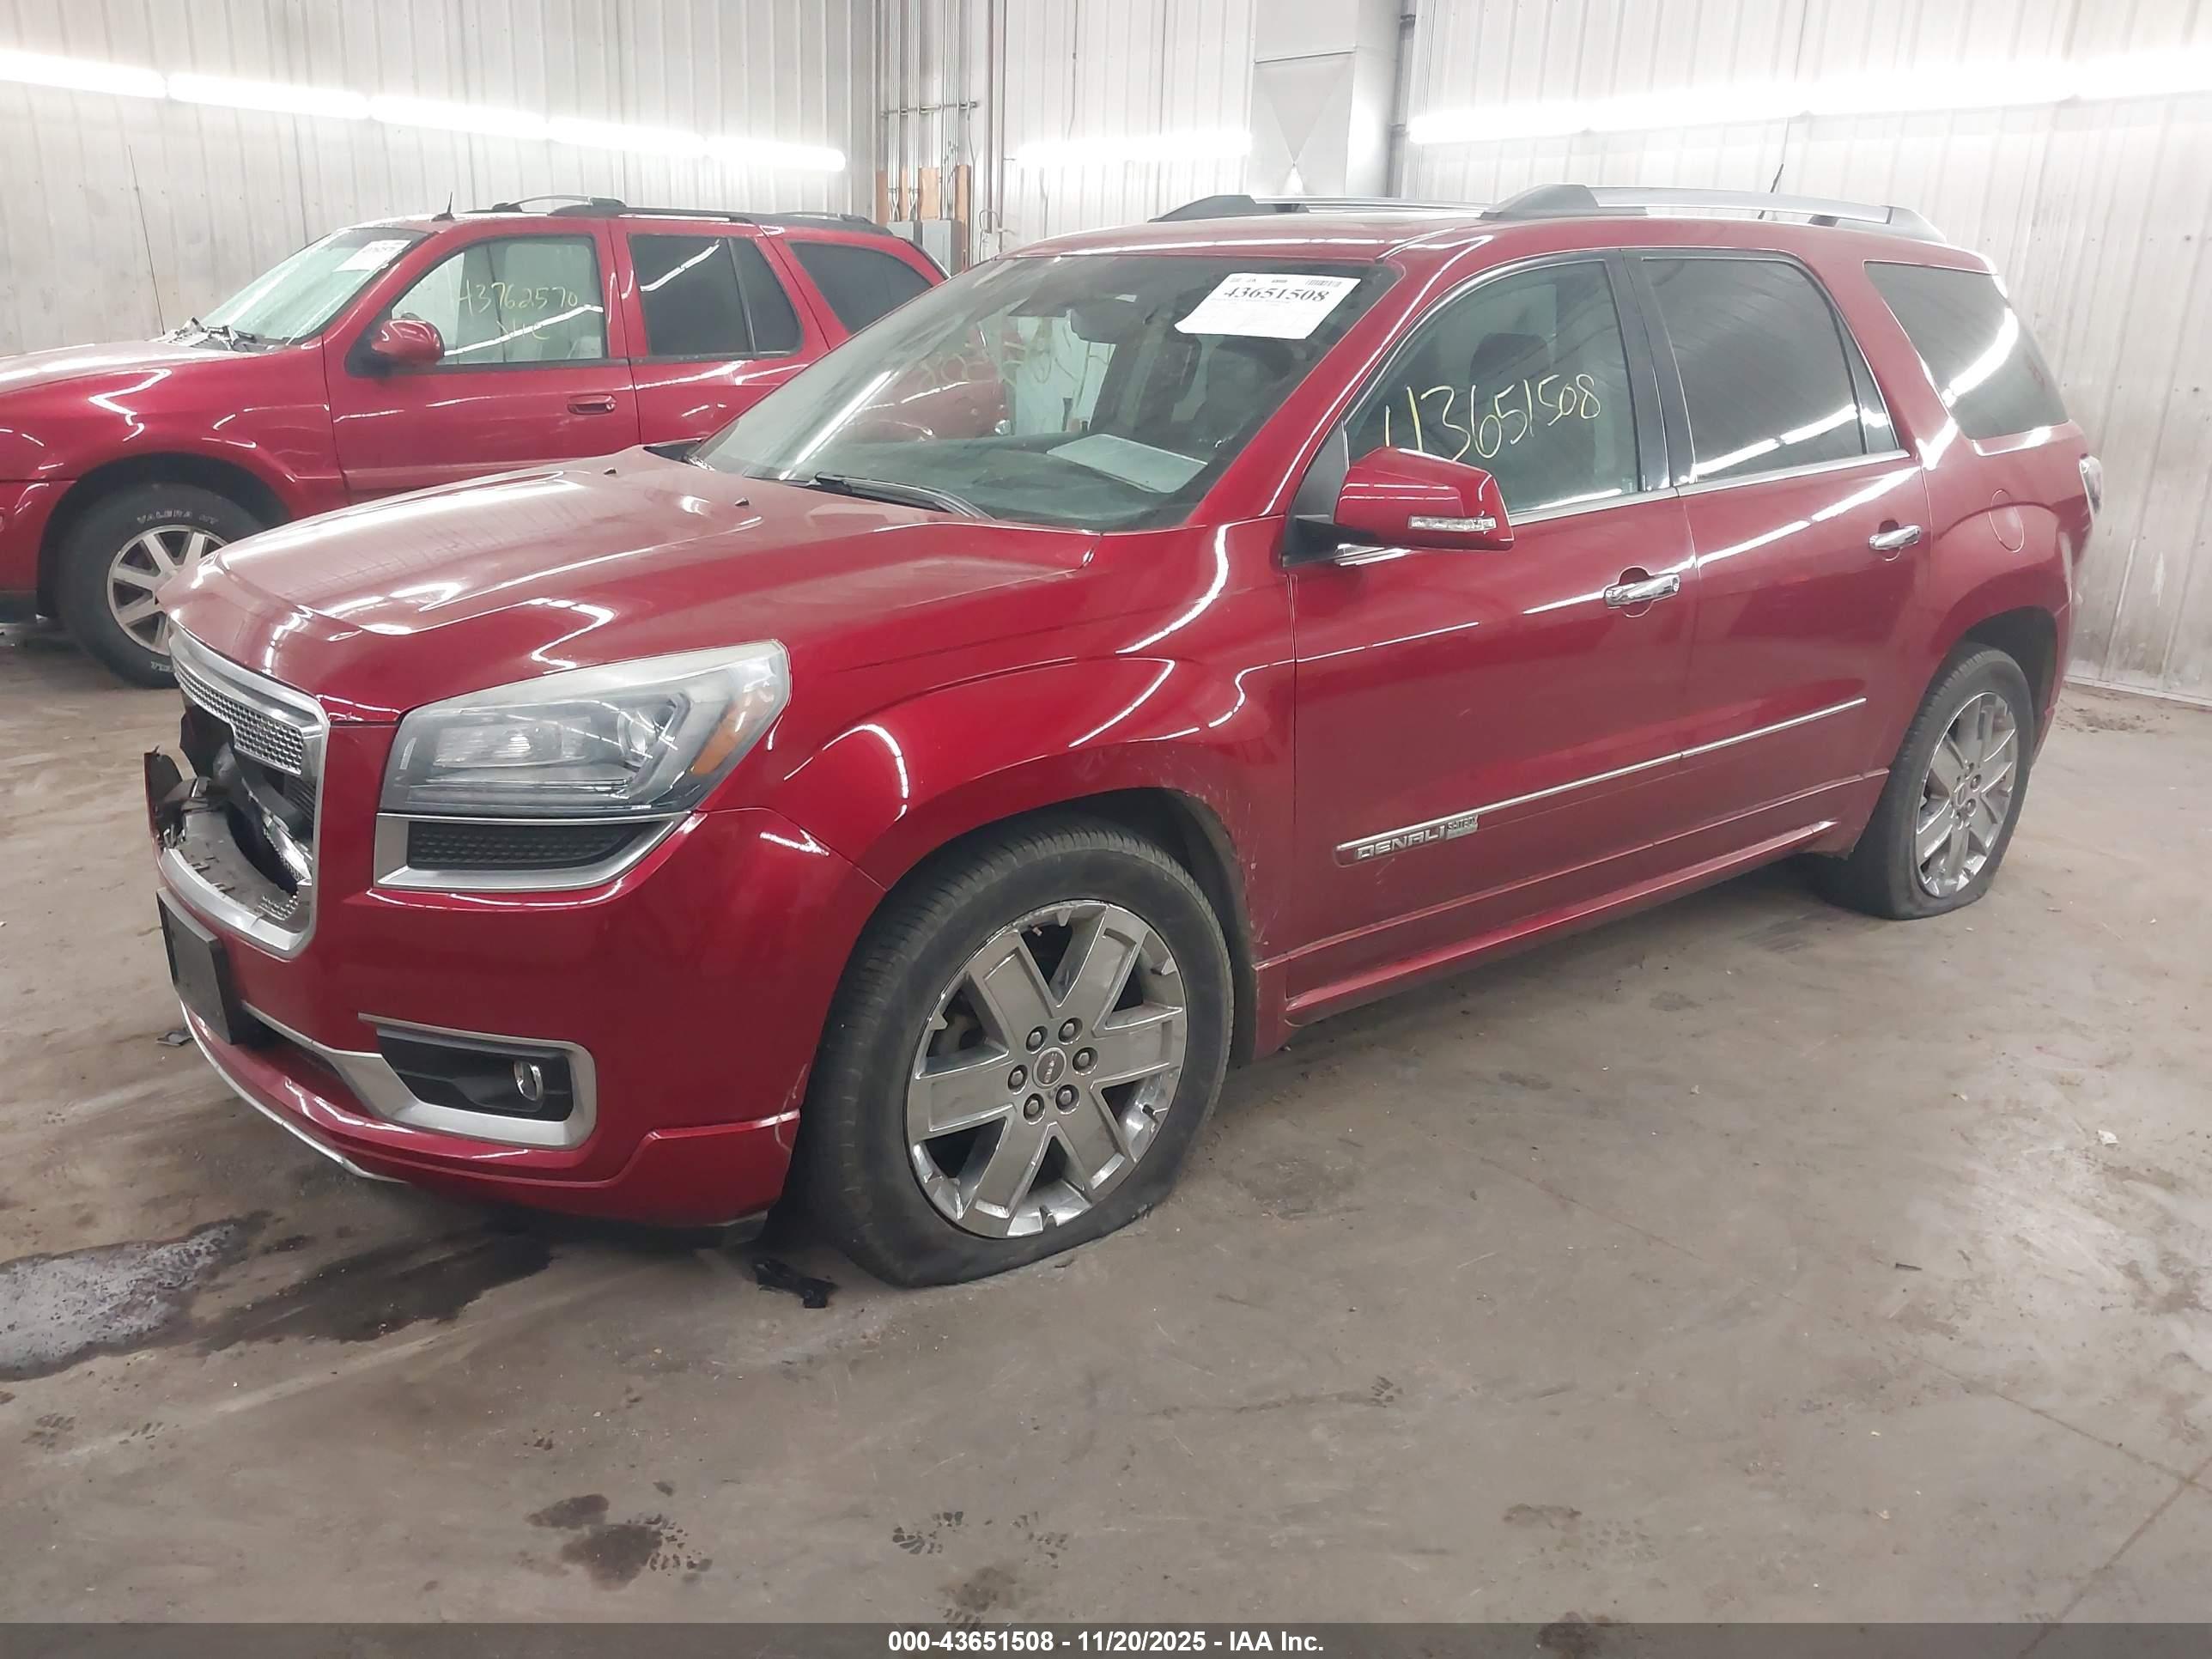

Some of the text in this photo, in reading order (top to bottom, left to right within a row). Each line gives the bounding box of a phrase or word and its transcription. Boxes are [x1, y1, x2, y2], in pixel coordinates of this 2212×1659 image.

[459, 279, 578, 316] 43762570
[1224, 287, 1330, 302] 43651508
[1356, 825, 1446, 860] DENALI
